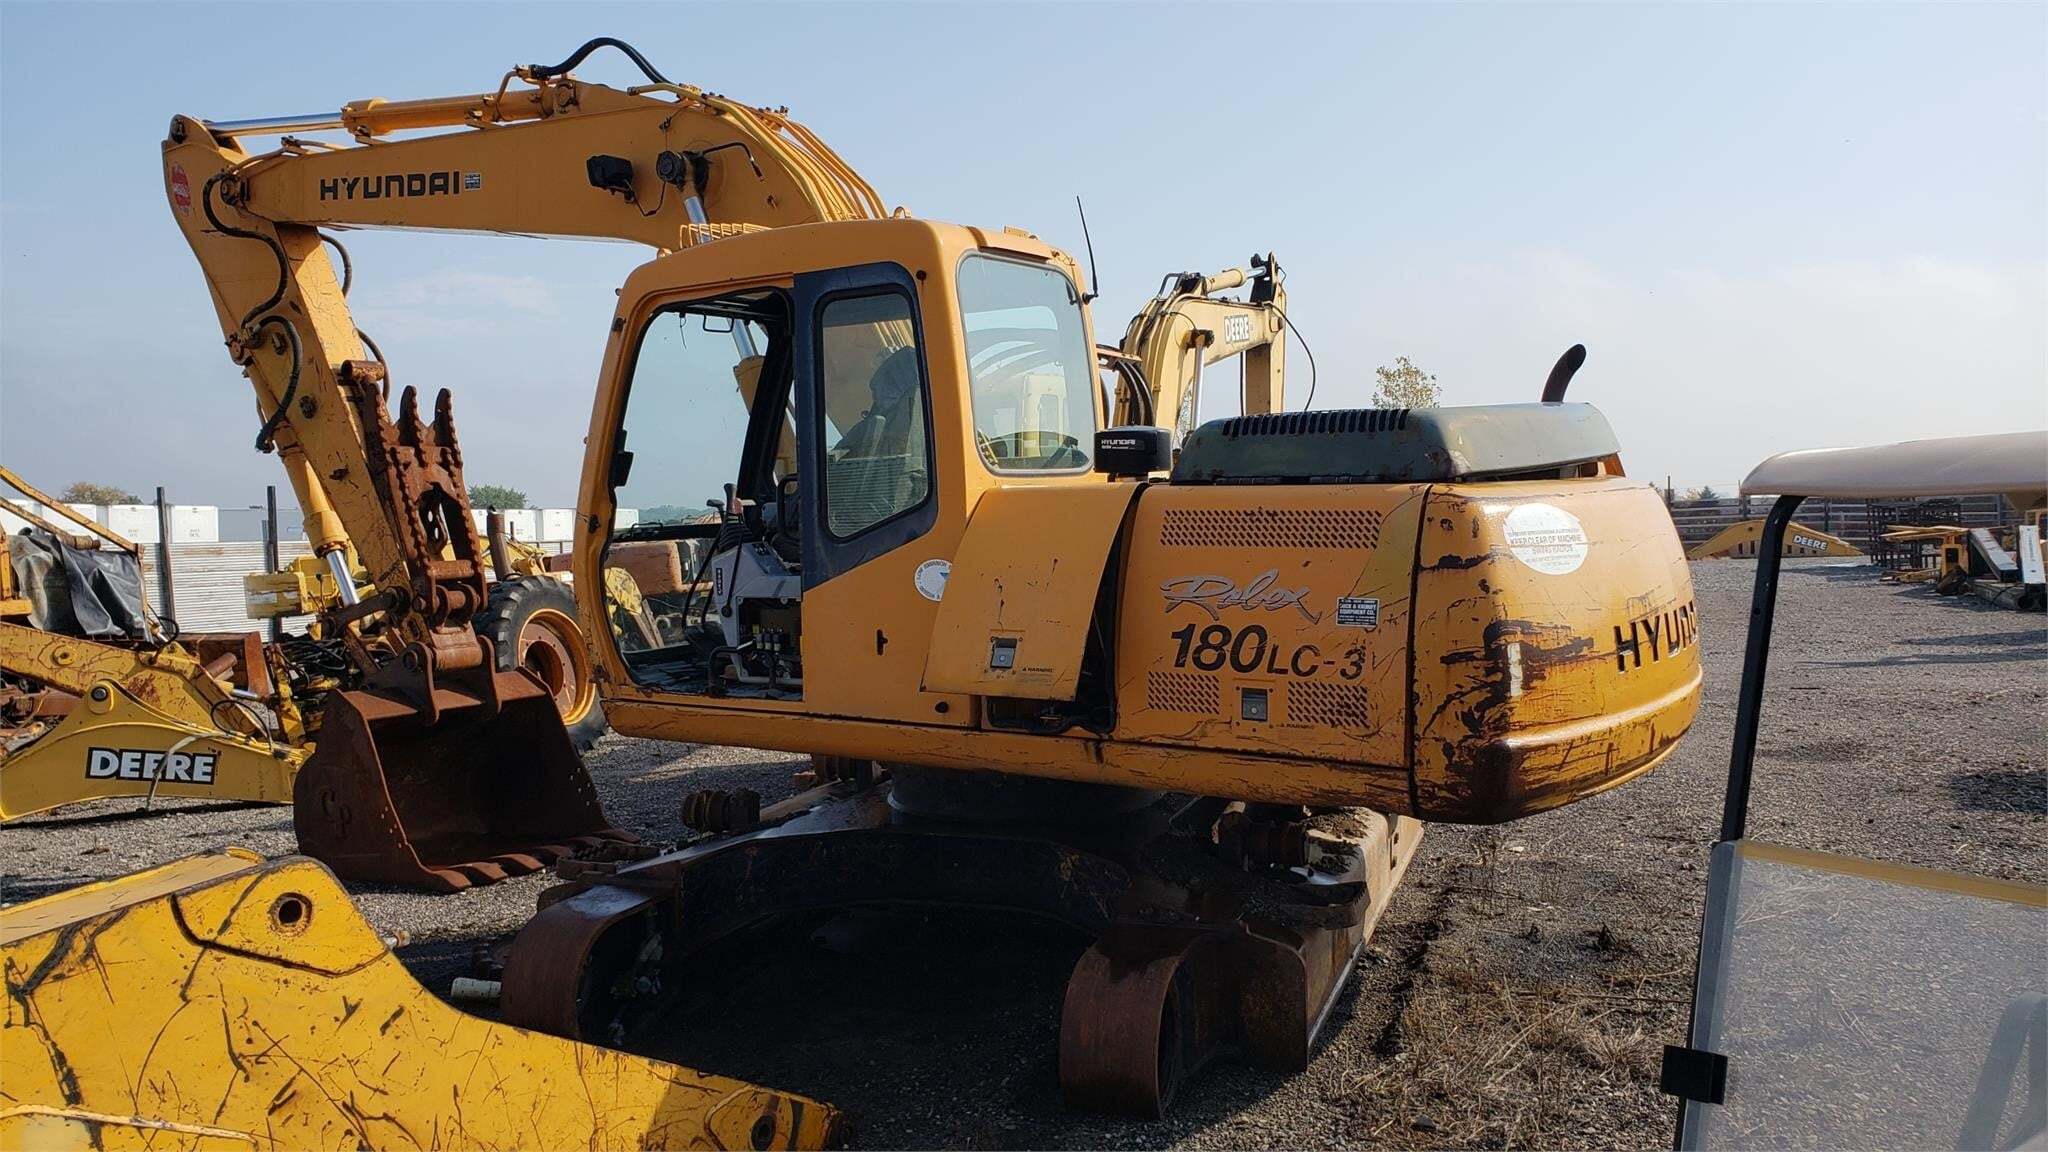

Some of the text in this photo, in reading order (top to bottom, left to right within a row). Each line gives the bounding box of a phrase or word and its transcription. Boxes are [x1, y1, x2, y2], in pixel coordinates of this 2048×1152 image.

[320, 171, 460, 201] HYUNDAI
[1224, 315, 1249, 342] DEERE
[1527, 536, 1547, 545] CLEAR
[1548, 535, 1557, 543] OF
[1793, 535, 1828, 550] DEERE
